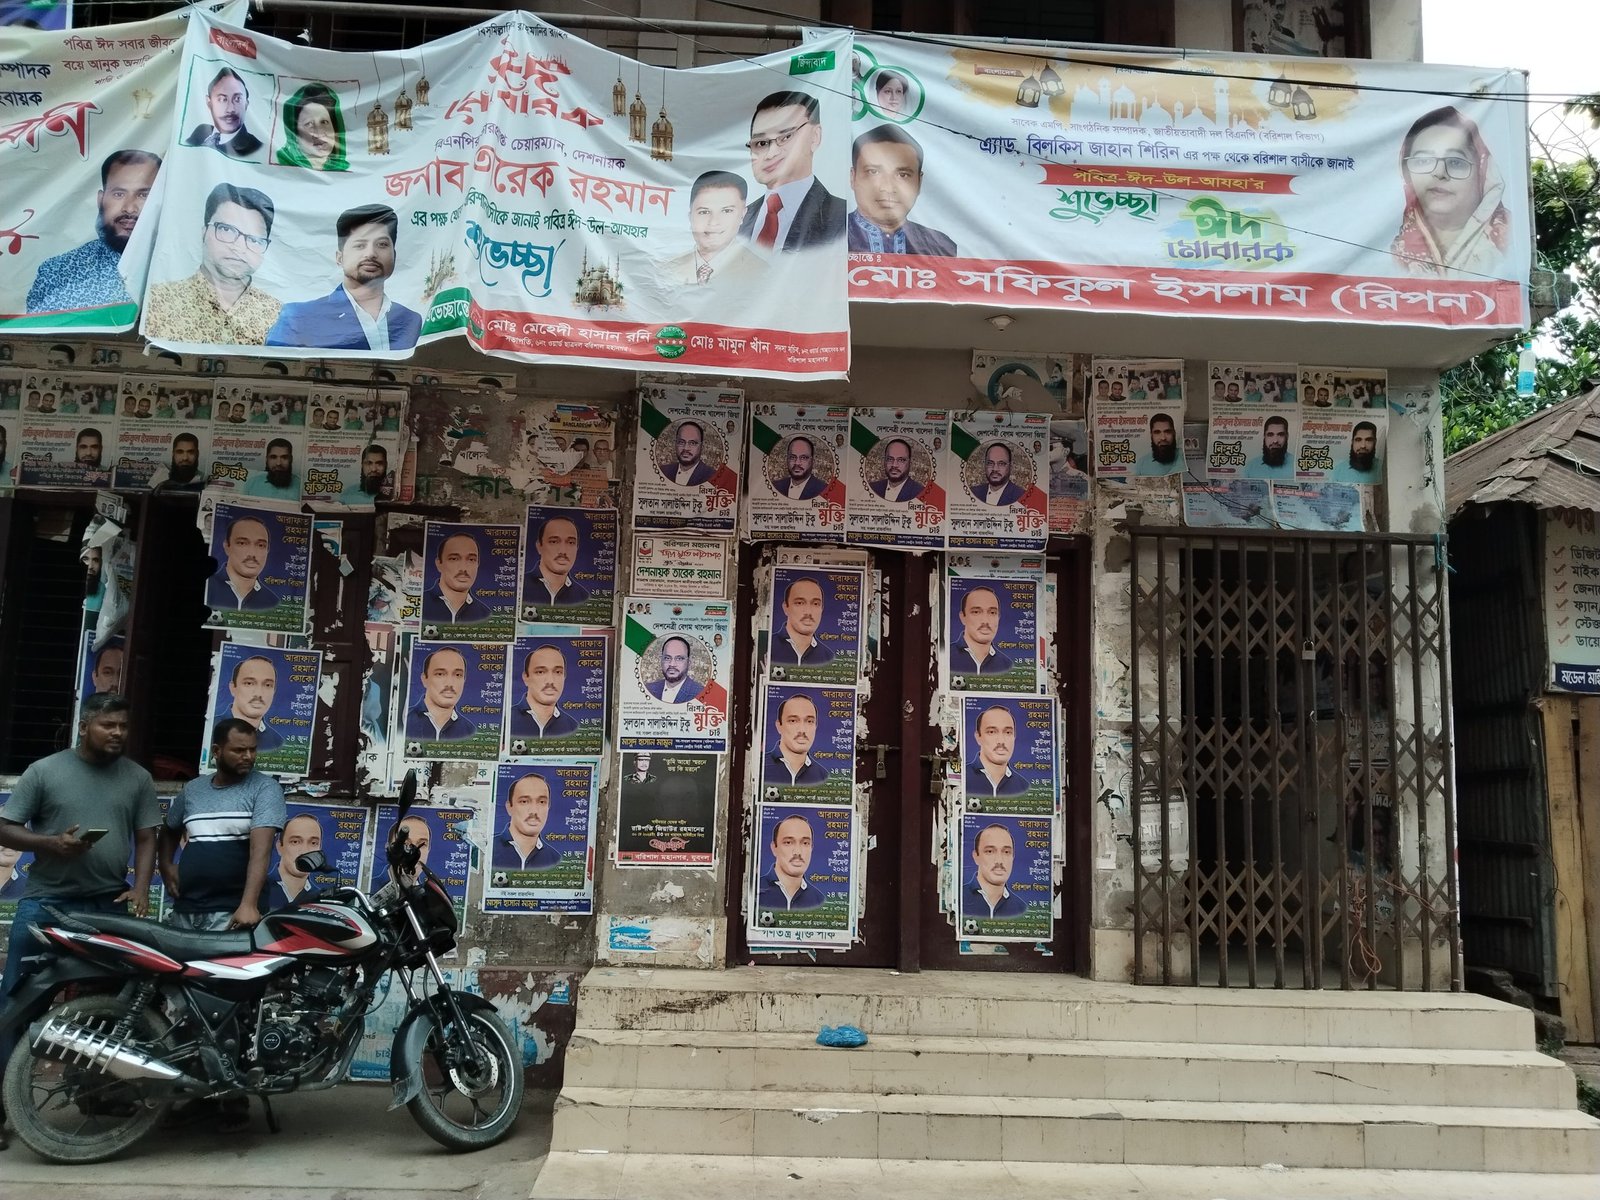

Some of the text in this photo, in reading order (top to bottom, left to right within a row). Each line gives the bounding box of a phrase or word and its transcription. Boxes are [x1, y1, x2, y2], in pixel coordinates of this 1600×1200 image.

[63, 36, 145, 51] পবিত্র ঈদ সবার
[0, 63, 51, 80] ম্পাদক
[62, 60, 120, 73] বয়ে আনুক
[0, 91, 43, 107] বায়ক
[1153, 126, 1206, 139] জাতীয়তাবাদী
[1209, 130, 1223, 139] দল
[1225, 128, 1256, 141] বিএনপি
[1026, 133, 1084, 156] বিলকিস
[1088, 140, 1133, 158] জাহান
[1137, 140, 1179, 160] শিরিন
[1183, 151, 1198, 162] এর
[1202, 151, 1220, 162] পক্ষ
[1224, 153, 1249, 163] থেকে
[1253, 152, 1287, 166] বরিশাল
[1291, 153, 1323, 168] বাসীকে
[1327, 157, 1355, 171] জানাই
[573, 150, 627, 171] দেশনায়ক
[383, 156, 469, 197] জনাব
[567, 167, 676, 217] রহমান
[1049, 187, 1159, 225] শুভেচ্ছা
[411, 210, 428, 227] এর
[430, 212, 449, 227] পক্ষ
[511, 211, 541, 231] জানাই
[543, 211, 566, 231] পবিত্র
[1185, 197, 1262, 239] ঈদ
[1167, 239, 1294, 263] মোবারক
[848, 264, 1496, 321] মোঃ সফিকুল ইসলাম (রিপন)
[487, 318, 653, 344] মোঃ মেহেদী হাসান রনি
[690, 334, 714, 350] মোঃ
[717, 337, 746, 356] মামুন
[1120, 451, 1136, 463] চাই
[1230, 453, 1246, 466] চাই
[705, 489, 735, 512] মুক্তি
[914, 506, 944, 528] মুক্তি
[636, 566, 721, 580] দেশনায়ক তারেক রহমান
[1561, 670, 1586, 686] মডেল
[821, 690, 854, 699] আরাফাত
[830, 700, 852, 709] রহমান
[694, 705, 724, 731] মুক্তি
[555, 769, 590, 778] আরাফাত
[565, 780, 588, 789] রহমান
[330, 810, 363, 820] আরাফাত
[817, 811, 850, 820] আরাফাত
[338, 822, 362, 830] রহমান
[826, 821, 849, 830] রহমান
